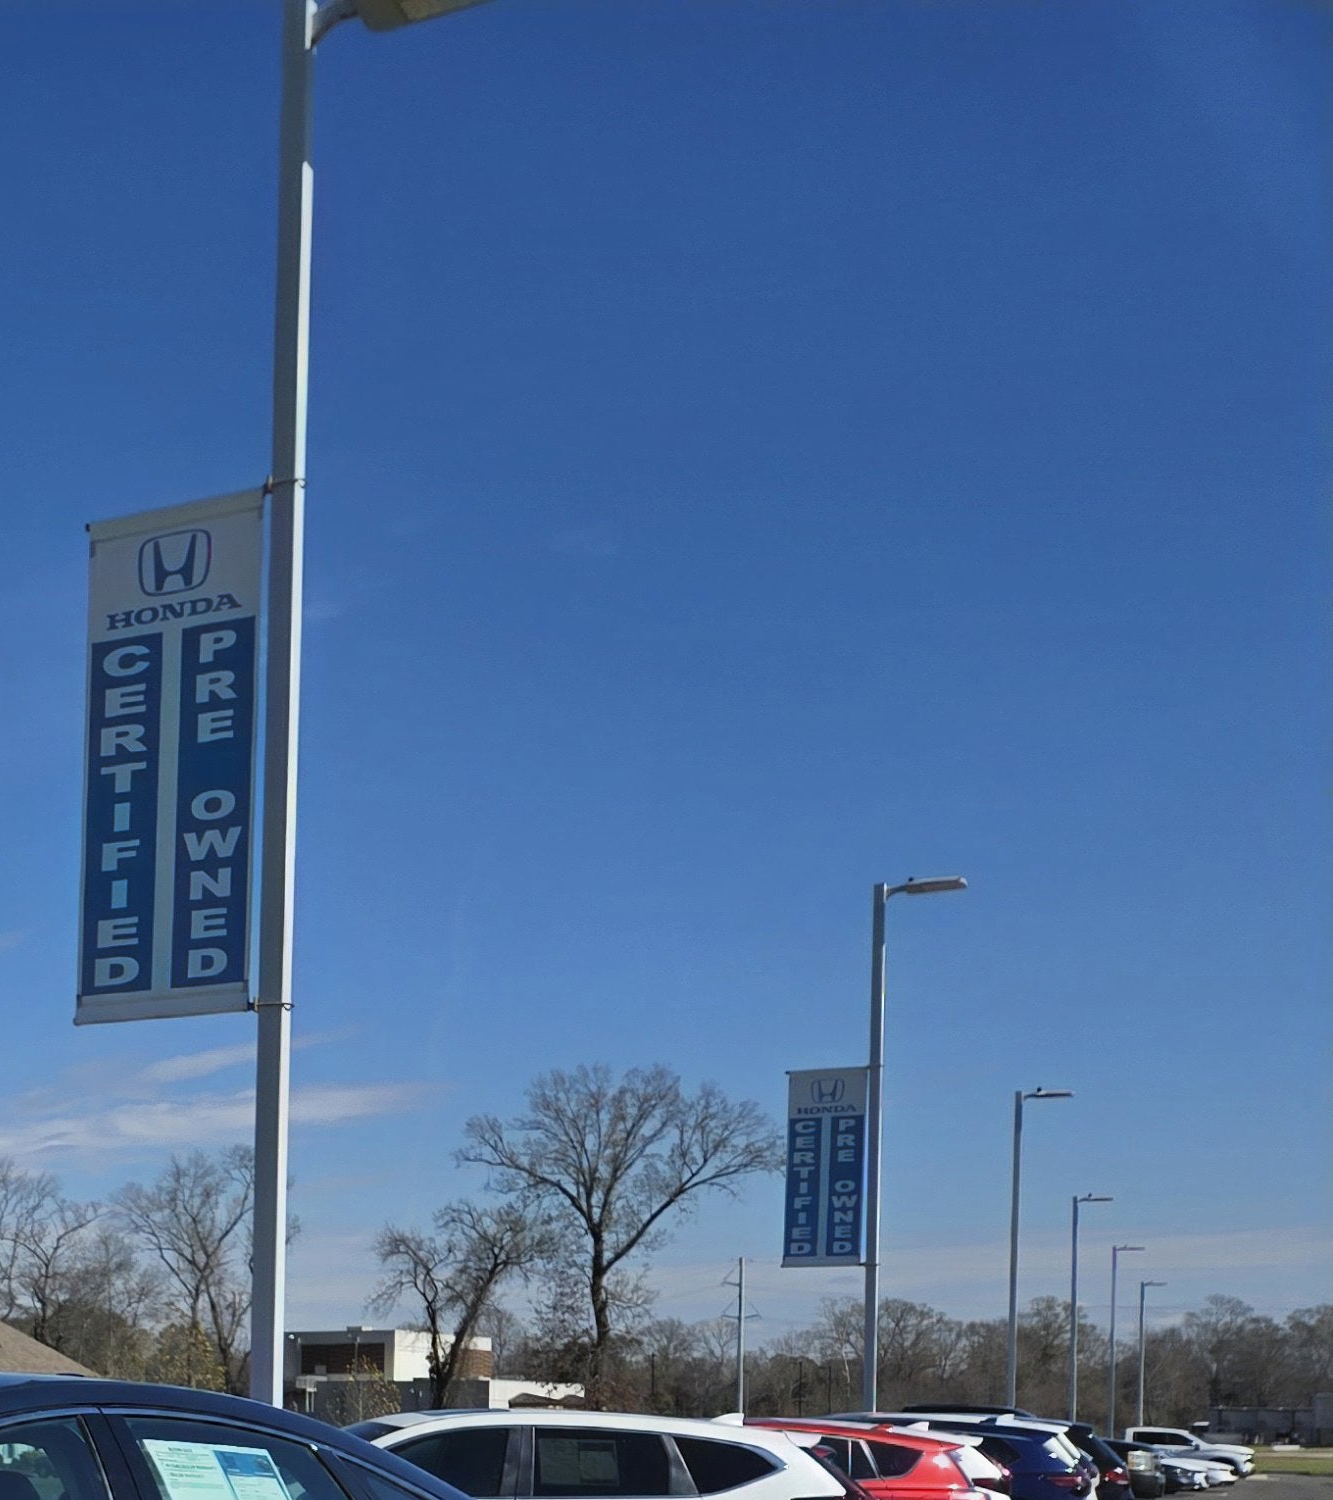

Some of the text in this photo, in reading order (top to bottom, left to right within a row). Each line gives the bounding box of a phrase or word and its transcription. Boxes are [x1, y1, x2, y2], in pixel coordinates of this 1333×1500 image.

[106, 593, 242, 631] HONDA
[94, 645, 151, 987] CERTIFIED
[183, 630, 242, 978] PRE OWNED
[797, 1104, 857, 1115] HONDA
[790, 1120, 815, 1255] CERTIFIED
[831, 1118, 857, 1254] PRE OWNED
